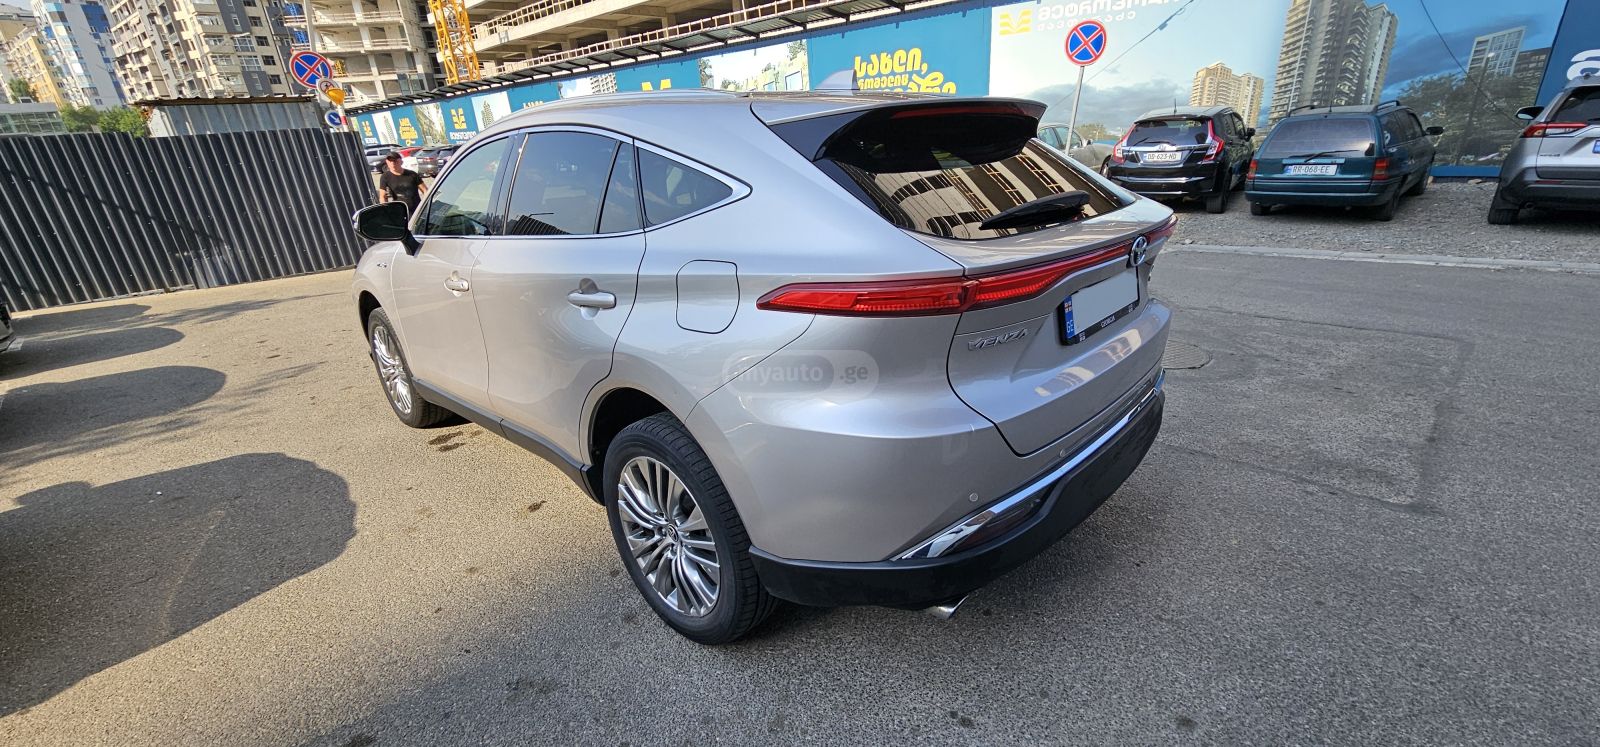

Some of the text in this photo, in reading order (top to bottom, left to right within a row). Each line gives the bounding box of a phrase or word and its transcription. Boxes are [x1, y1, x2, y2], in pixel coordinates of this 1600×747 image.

[854, 47, 928, 77] სახლი,
[1292, 164, 1331, 174] RR-068-EE
[967, 328, 1028, 351] VENZA
